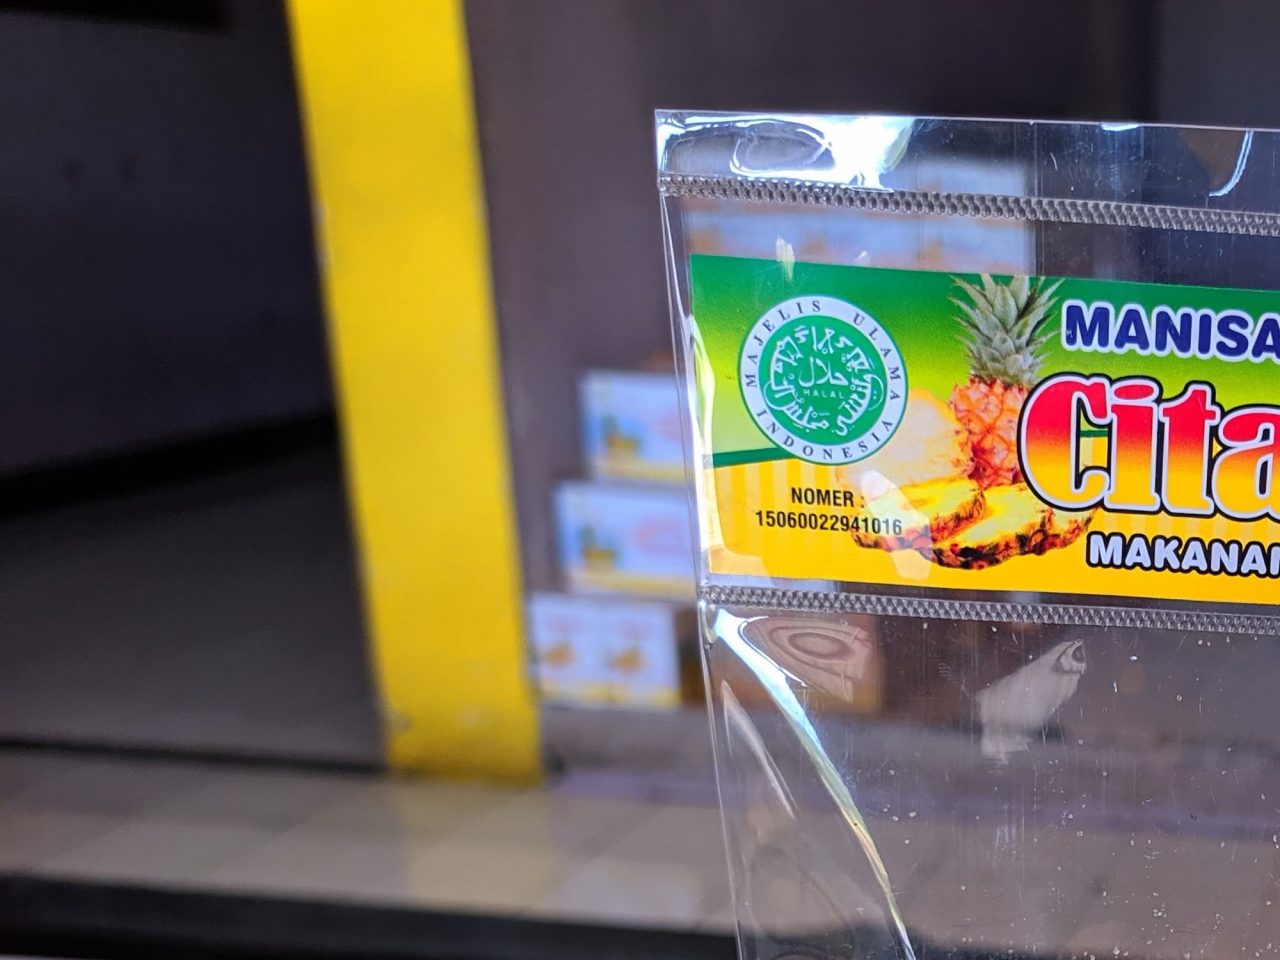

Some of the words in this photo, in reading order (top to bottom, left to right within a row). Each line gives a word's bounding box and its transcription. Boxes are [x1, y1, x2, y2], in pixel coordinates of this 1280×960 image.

[745, 300, 822, 388] MAJELIS
[853, 313, 901, 401] ULAMA
[803, 388, 845, 400] HALAL
[756, 408, 893, 461] INDONESIA
[791, 487, 855, 508] NOMER
[755, 510, 903, 536] 15060022941016
